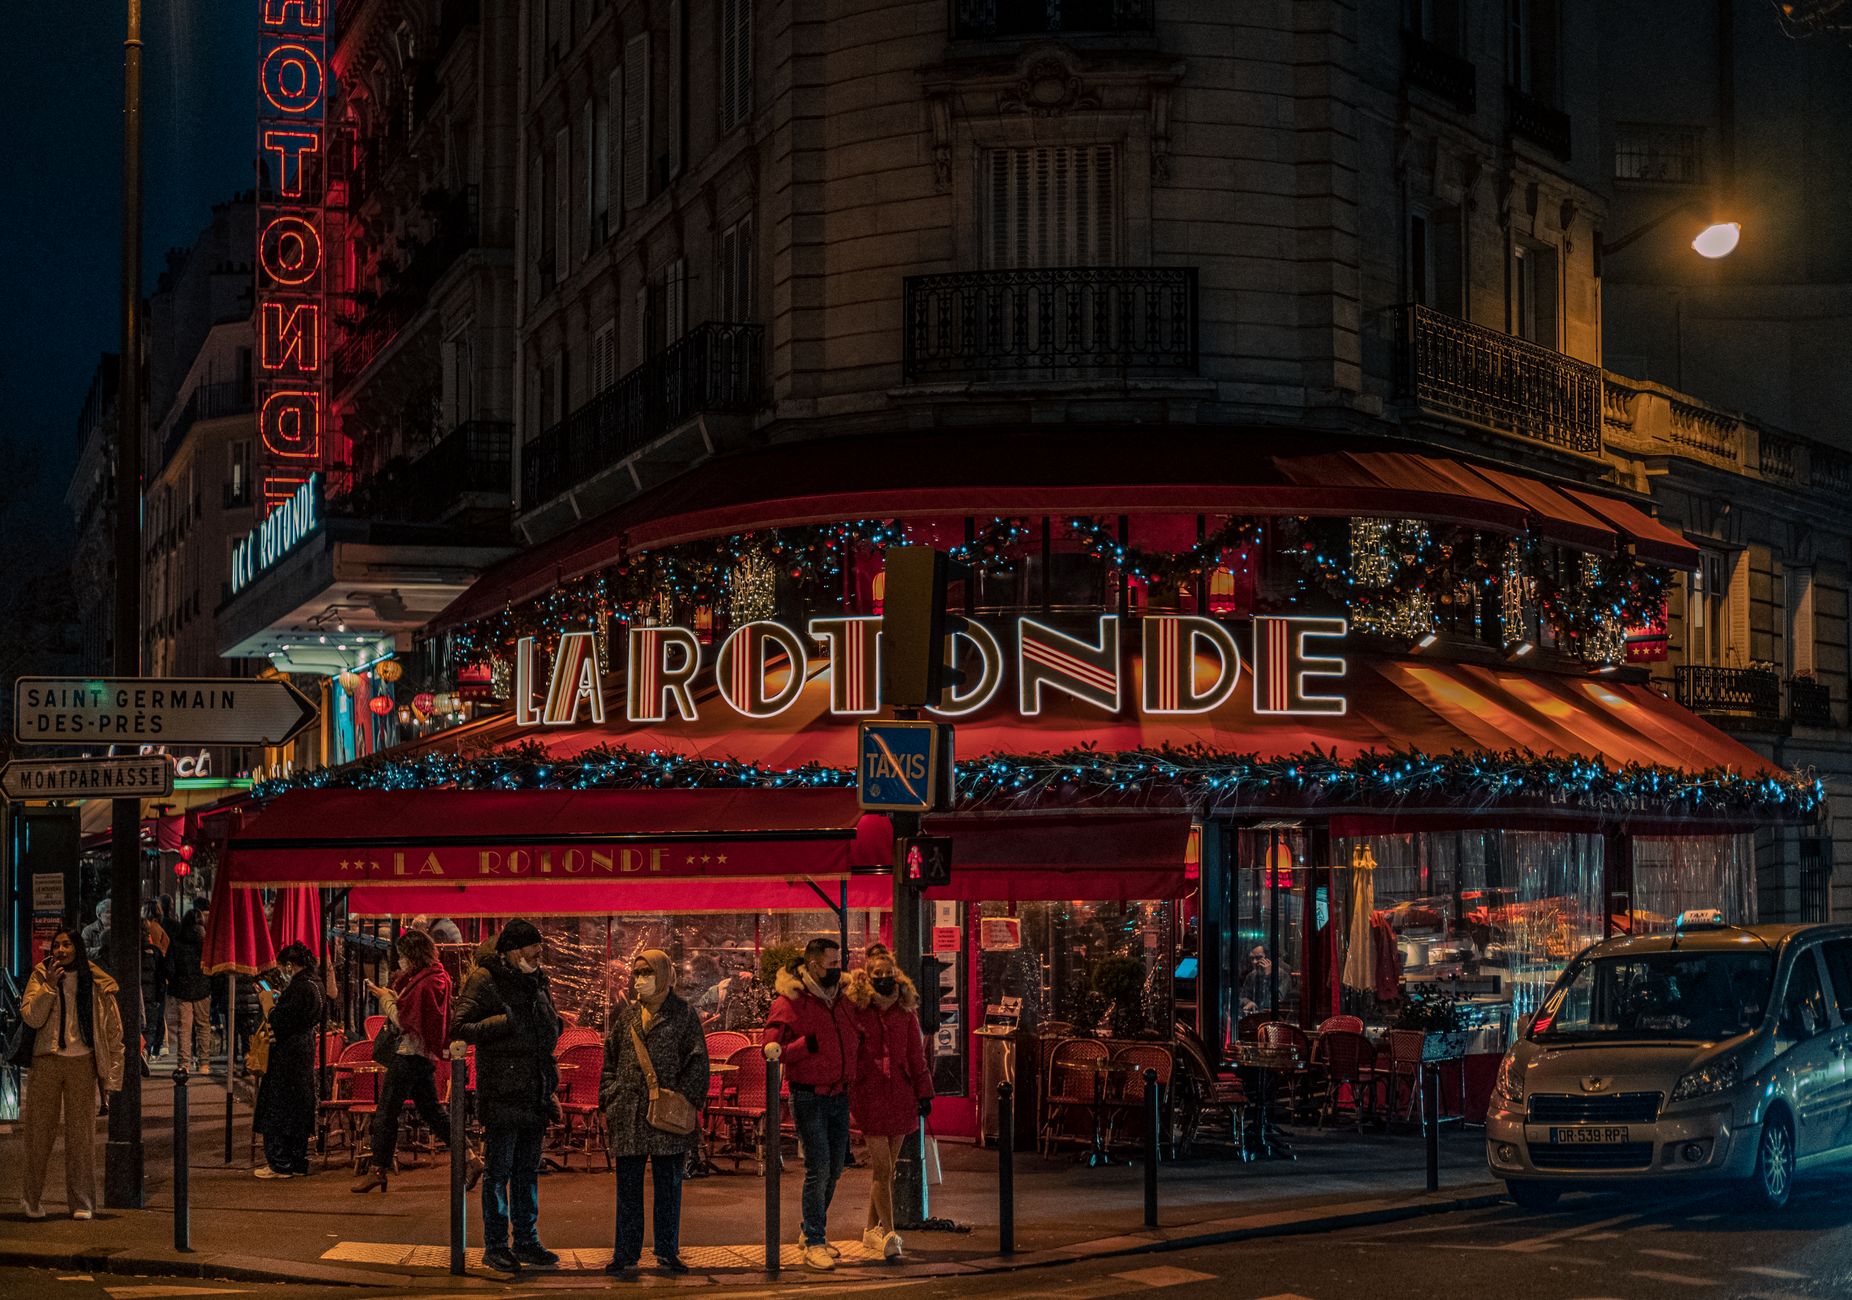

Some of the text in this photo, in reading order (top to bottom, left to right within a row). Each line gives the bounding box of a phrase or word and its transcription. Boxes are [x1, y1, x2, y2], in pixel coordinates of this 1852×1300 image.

[232, 472, 317, 595] UGC ROTONDE
[516, 632, 606, 726] LA
[27, 689, 235, 709] SAINT GERMAIN
[20, 767, 160, 789] MONTPARNASSE
[866, 753, 926, 779] TAXIS
[393, 848, 670, 876] LA ROTONDE
